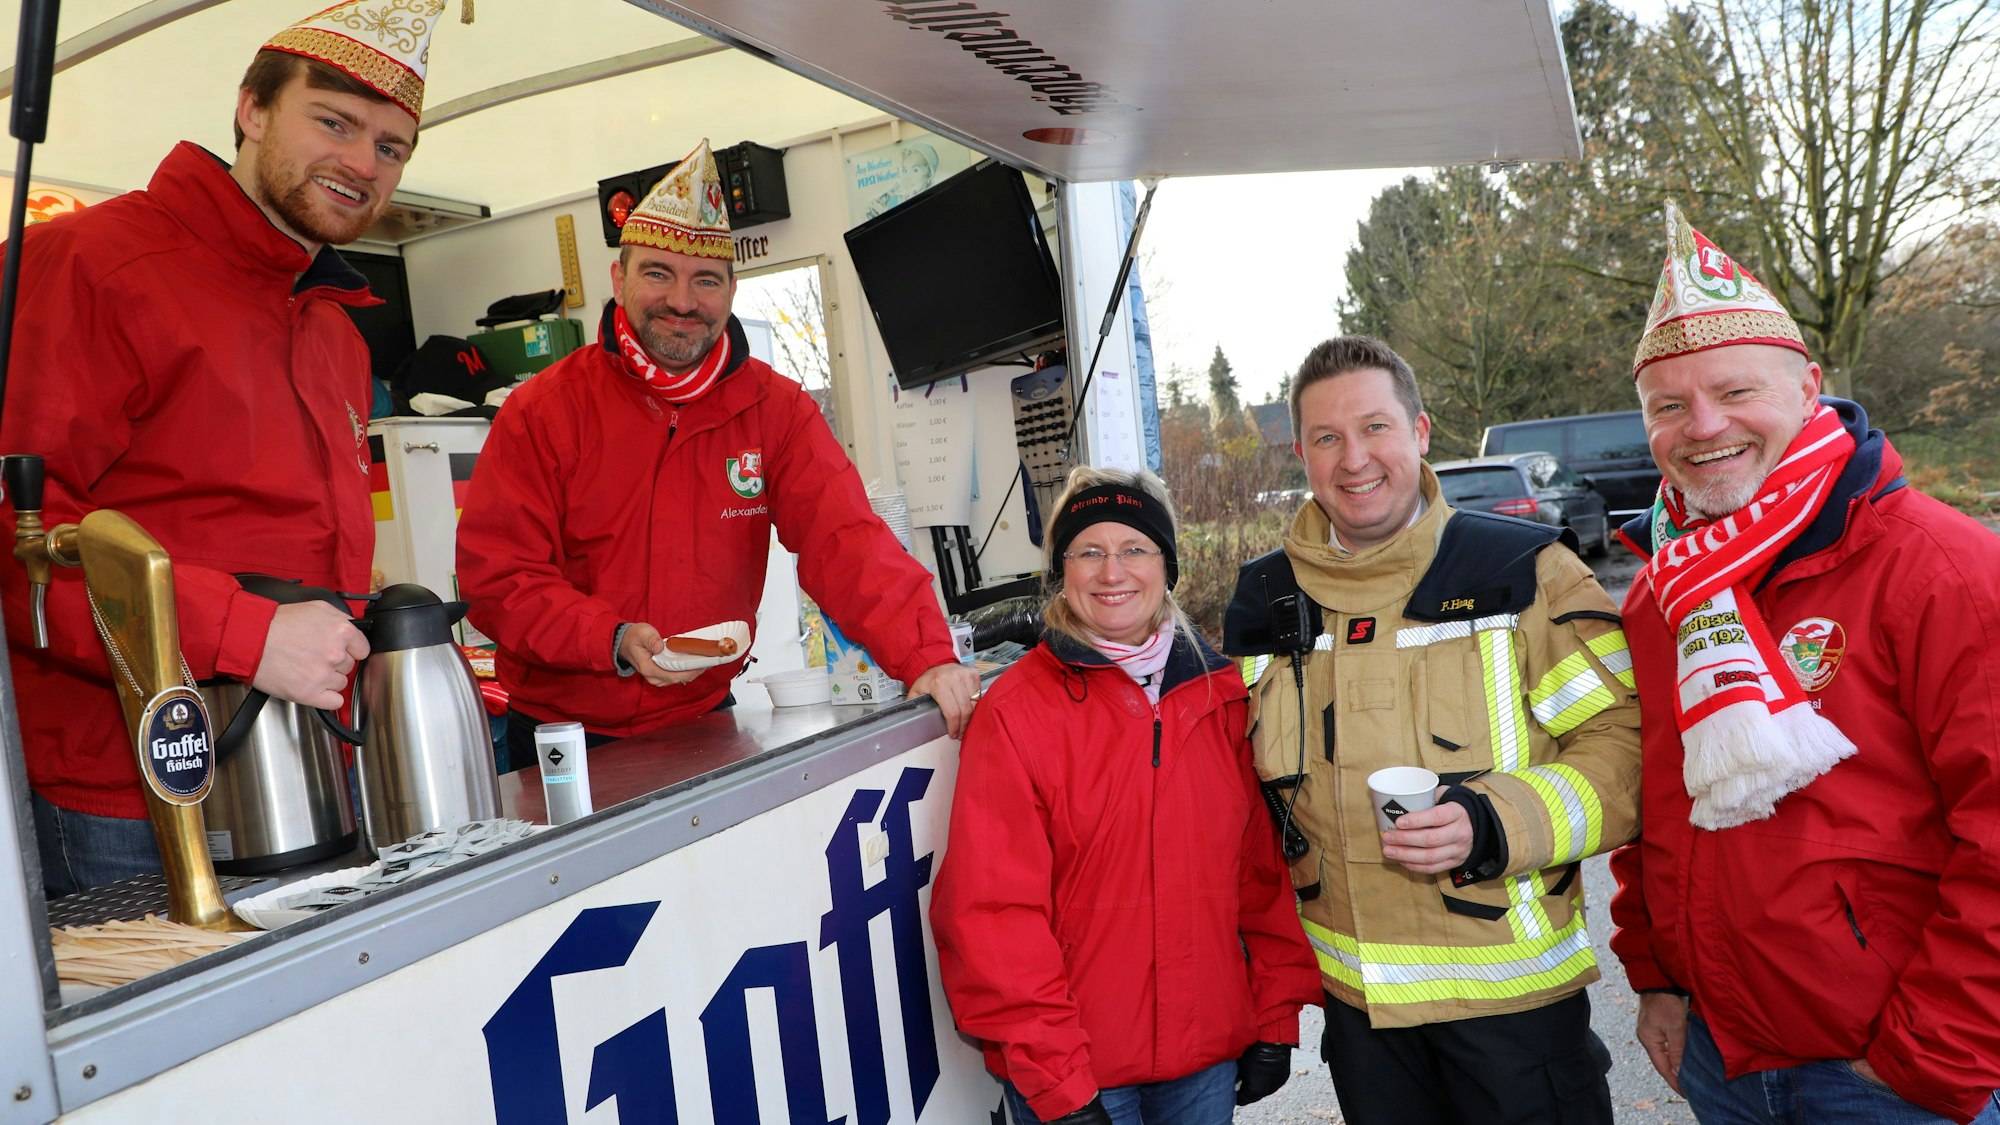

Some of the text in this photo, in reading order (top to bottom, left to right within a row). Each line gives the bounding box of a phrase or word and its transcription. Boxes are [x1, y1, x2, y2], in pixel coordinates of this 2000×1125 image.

[877, 0, 1144, 115] Jägermeist
[858, 174, 876, 189] PEPSI
[644, 198, 689, 218] Präsident
[734, 234, 769, 265] ister
[929, 398, 942, 407] 1,00
[896, 421, 916, 429] Wasser
[929, 417, 942, 426] 1,00
[930, 437, 943, 445] 1,00
[929, 456, 942, 464] 1,00
[928, 475, 941, 483] 1,00
[926, 505, 939, 513] 1,50
[1071, 495, 1110, 513] Strunde
[1683, 628, 1747, 659] von 192
[152, 732, 209, 760] Gaffel
[482, 766, 940, 1125] Gaff
